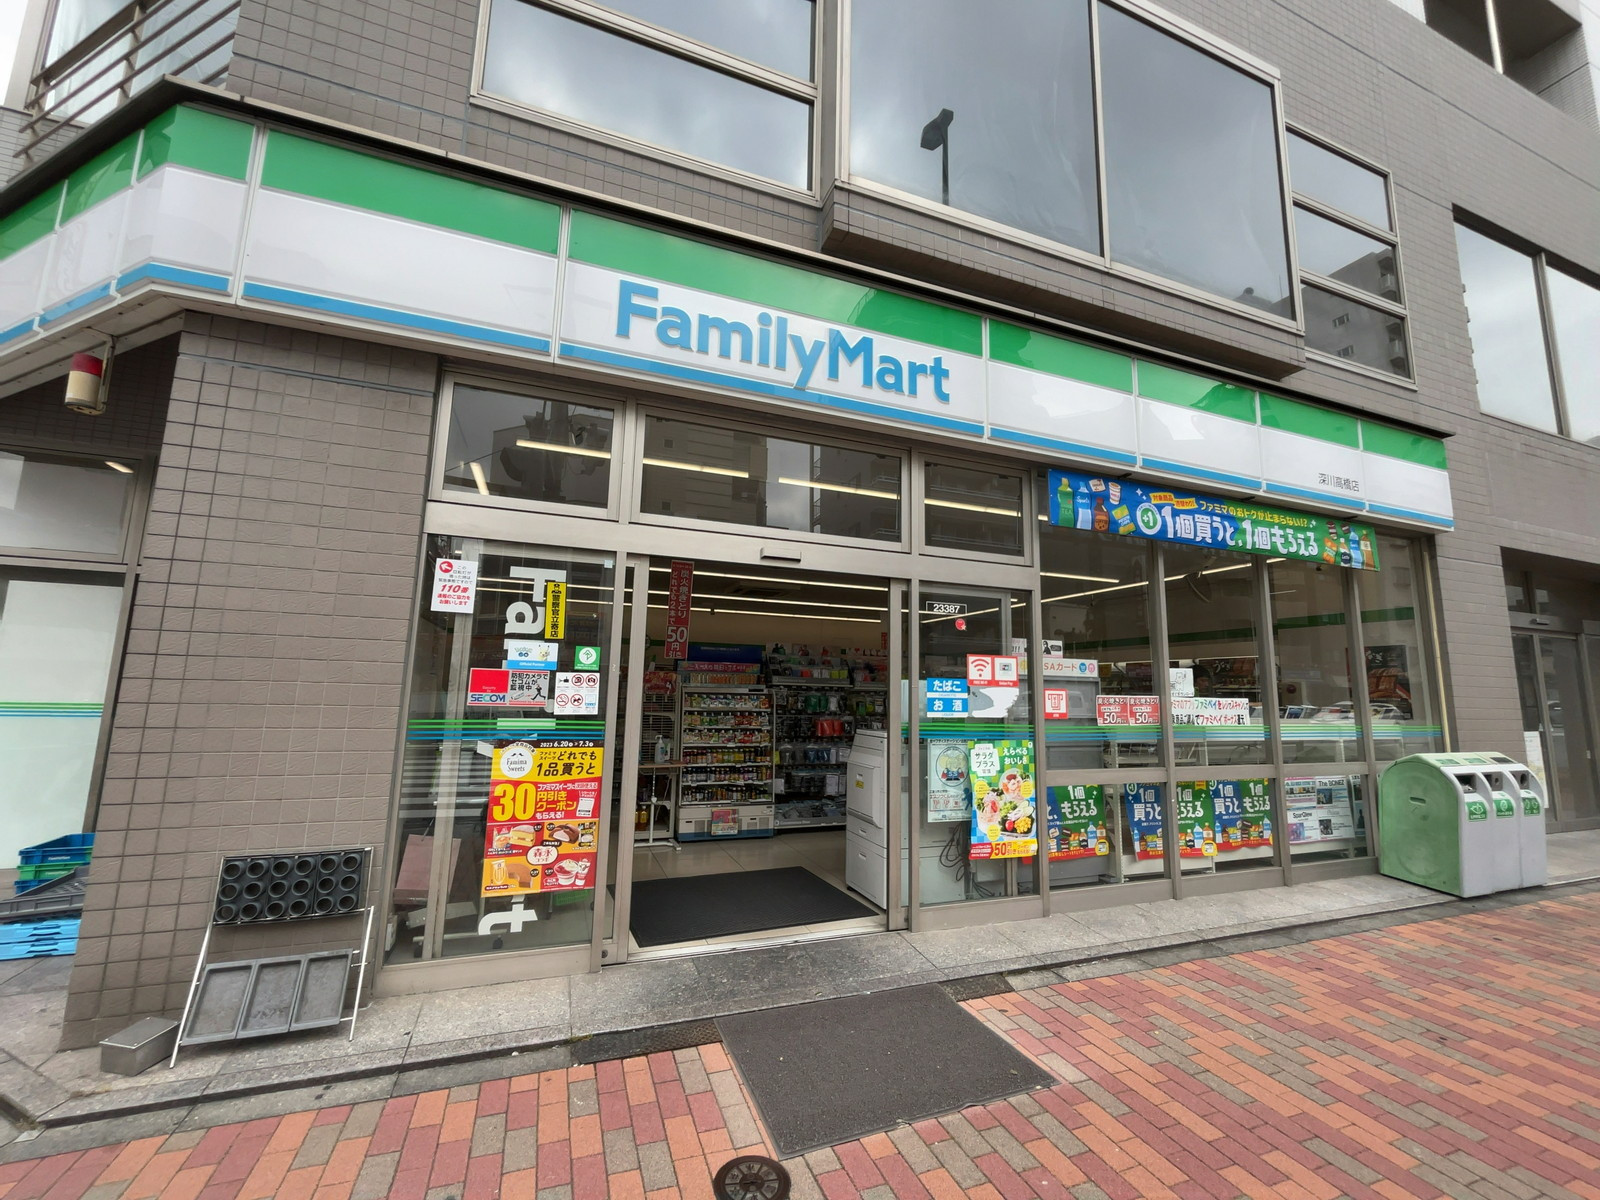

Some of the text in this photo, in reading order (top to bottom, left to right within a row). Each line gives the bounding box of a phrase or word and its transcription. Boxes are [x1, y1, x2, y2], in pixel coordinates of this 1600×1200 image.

[615, 279, 950, 404] FamilyMart
[1318, 473, 1360, 492] 深川高橋店
[440, 583, 470, 594] 110番
[933, 604, 961, 613] 23387
[667, 626, 688, 643] 50
[933, 679, 961, 691] たばこ
[470, 694, 506, 702] SECOM
[557, 751, 597, 761] どれでも
[1003, 747, 1028, 756] えらべる
[1004, 756, 1027, 764] おいしさ
[536, 762, 596, 777] 1品買うと
[1068, 785, 1085, 800] 1個
[1138, 788, 1155, 803] 1個
[1218, 784, 1234, 797] 1個
[1249, 782, 1263, 796] 1個
[493, 783, 536, 821] 30
[537, 791, 567, 802] 円引き
[536, 801, 577, 812] クーポン
[1061, 799, 1097, 819] もらえる
[1243, 796, 1271, 812] もらえる
[994, 842, 1007, 856] 50
